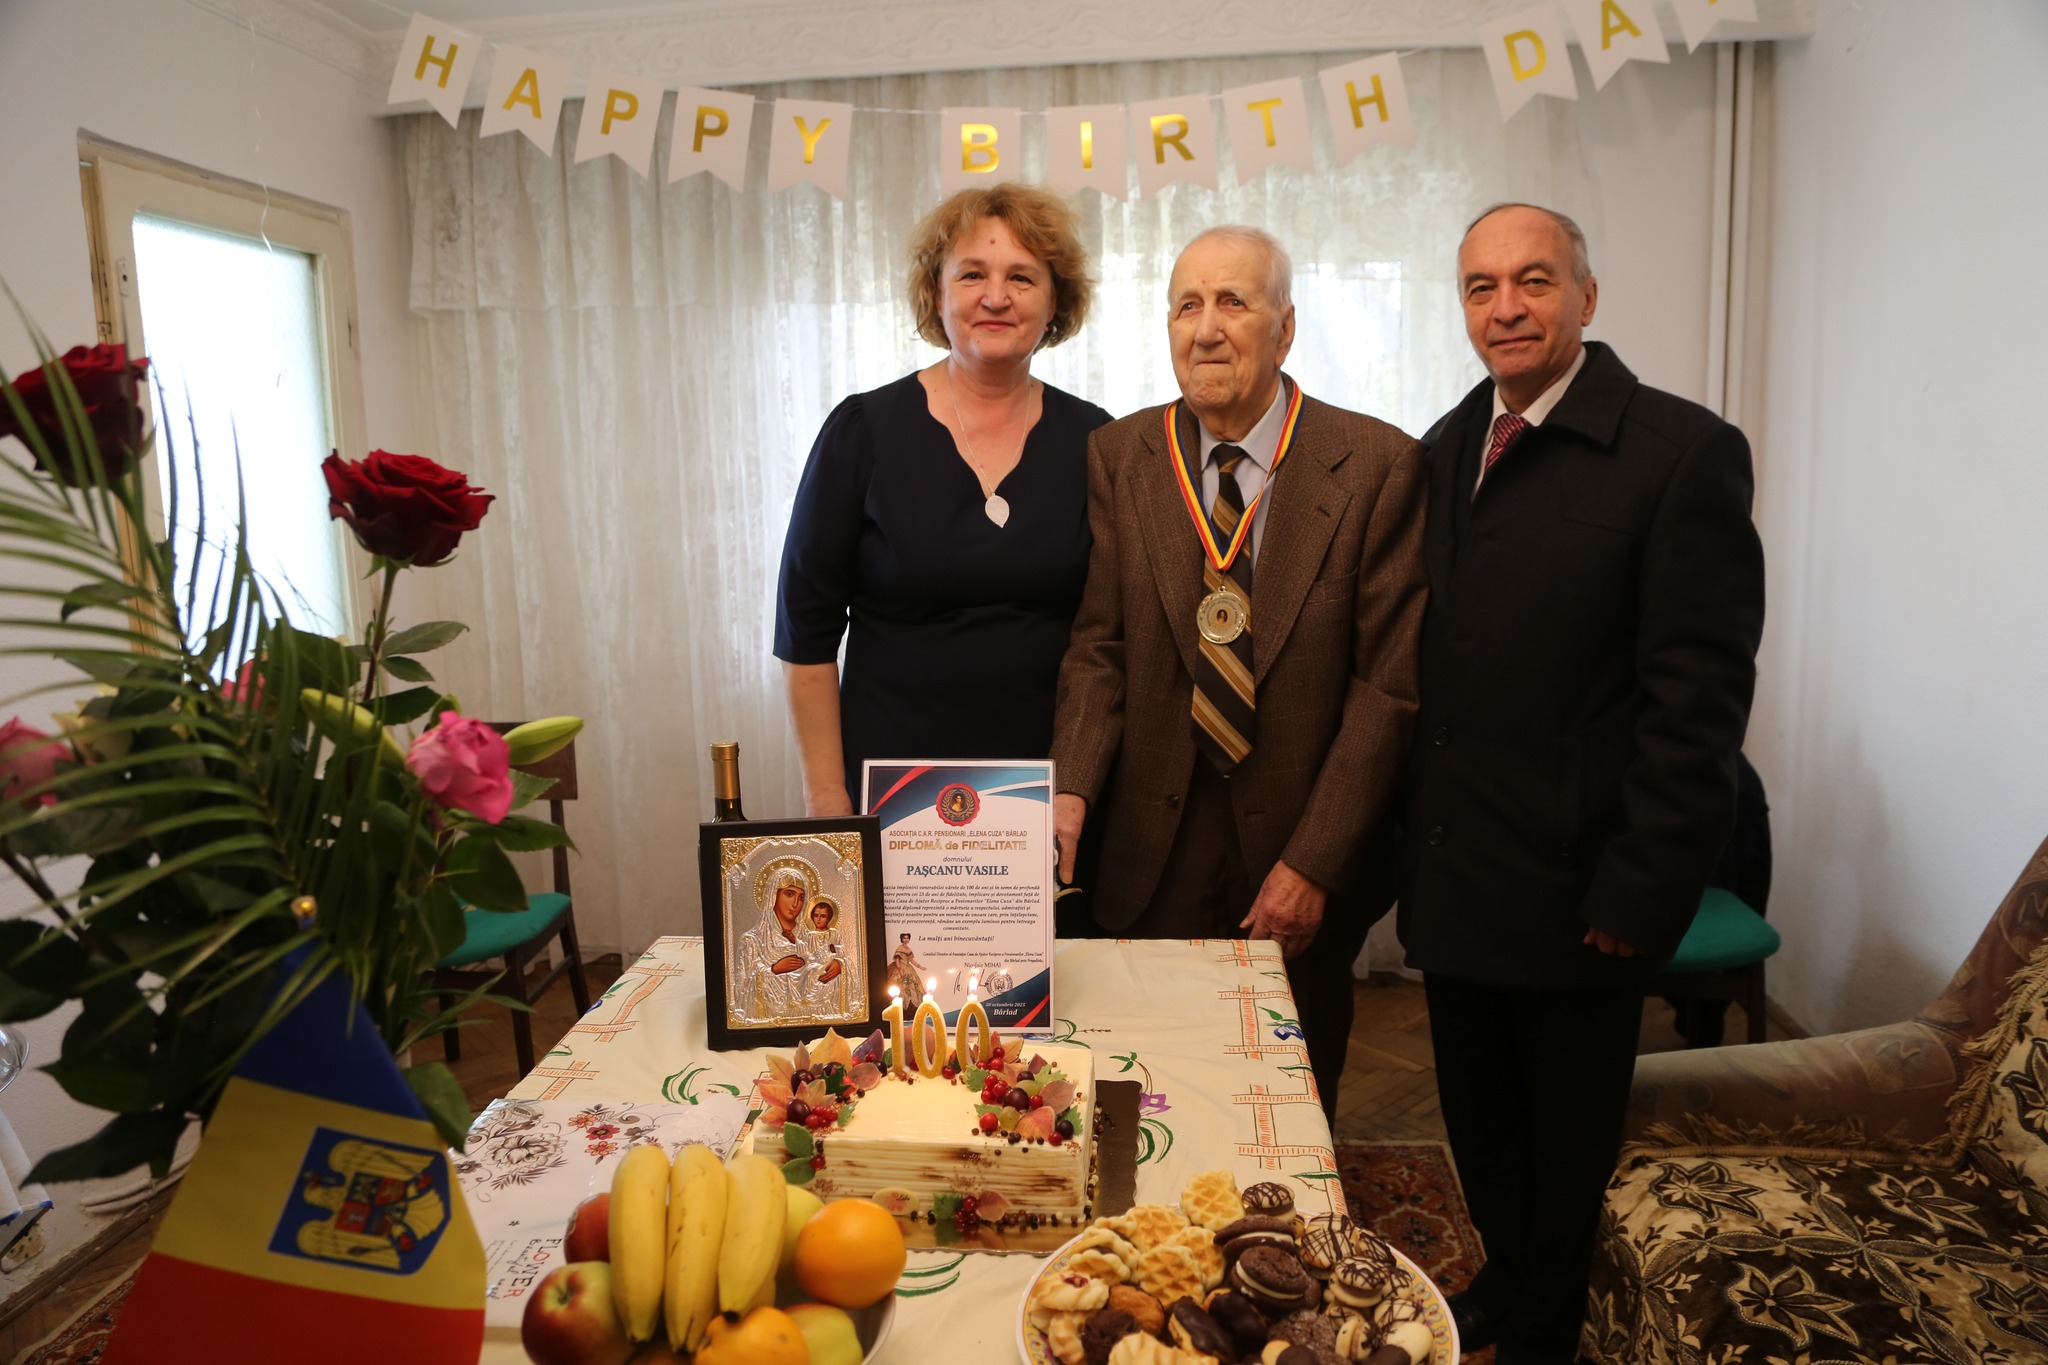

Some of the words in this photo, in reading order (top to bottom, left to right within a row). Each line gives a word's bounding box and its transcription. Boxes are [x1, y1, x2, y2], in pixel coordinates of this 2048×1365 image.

[413, 35, 832, 164] HAPPY
[961, 74, 1389, 173] BIRTH
[1503, 0, 1718, 82] DA
[889, 838, 942, 850] DIPLOMĂ
[945, 841, 959, 850] de
[962, 840, 1027, 850] FIDELITATE
[906, 865, 963, 877] PAȘCANU
[965, 866, 1009, 875] VASILE
[882, 996, 990, 1079] 100
[503, 1238, 562, 1298] FLOWER
